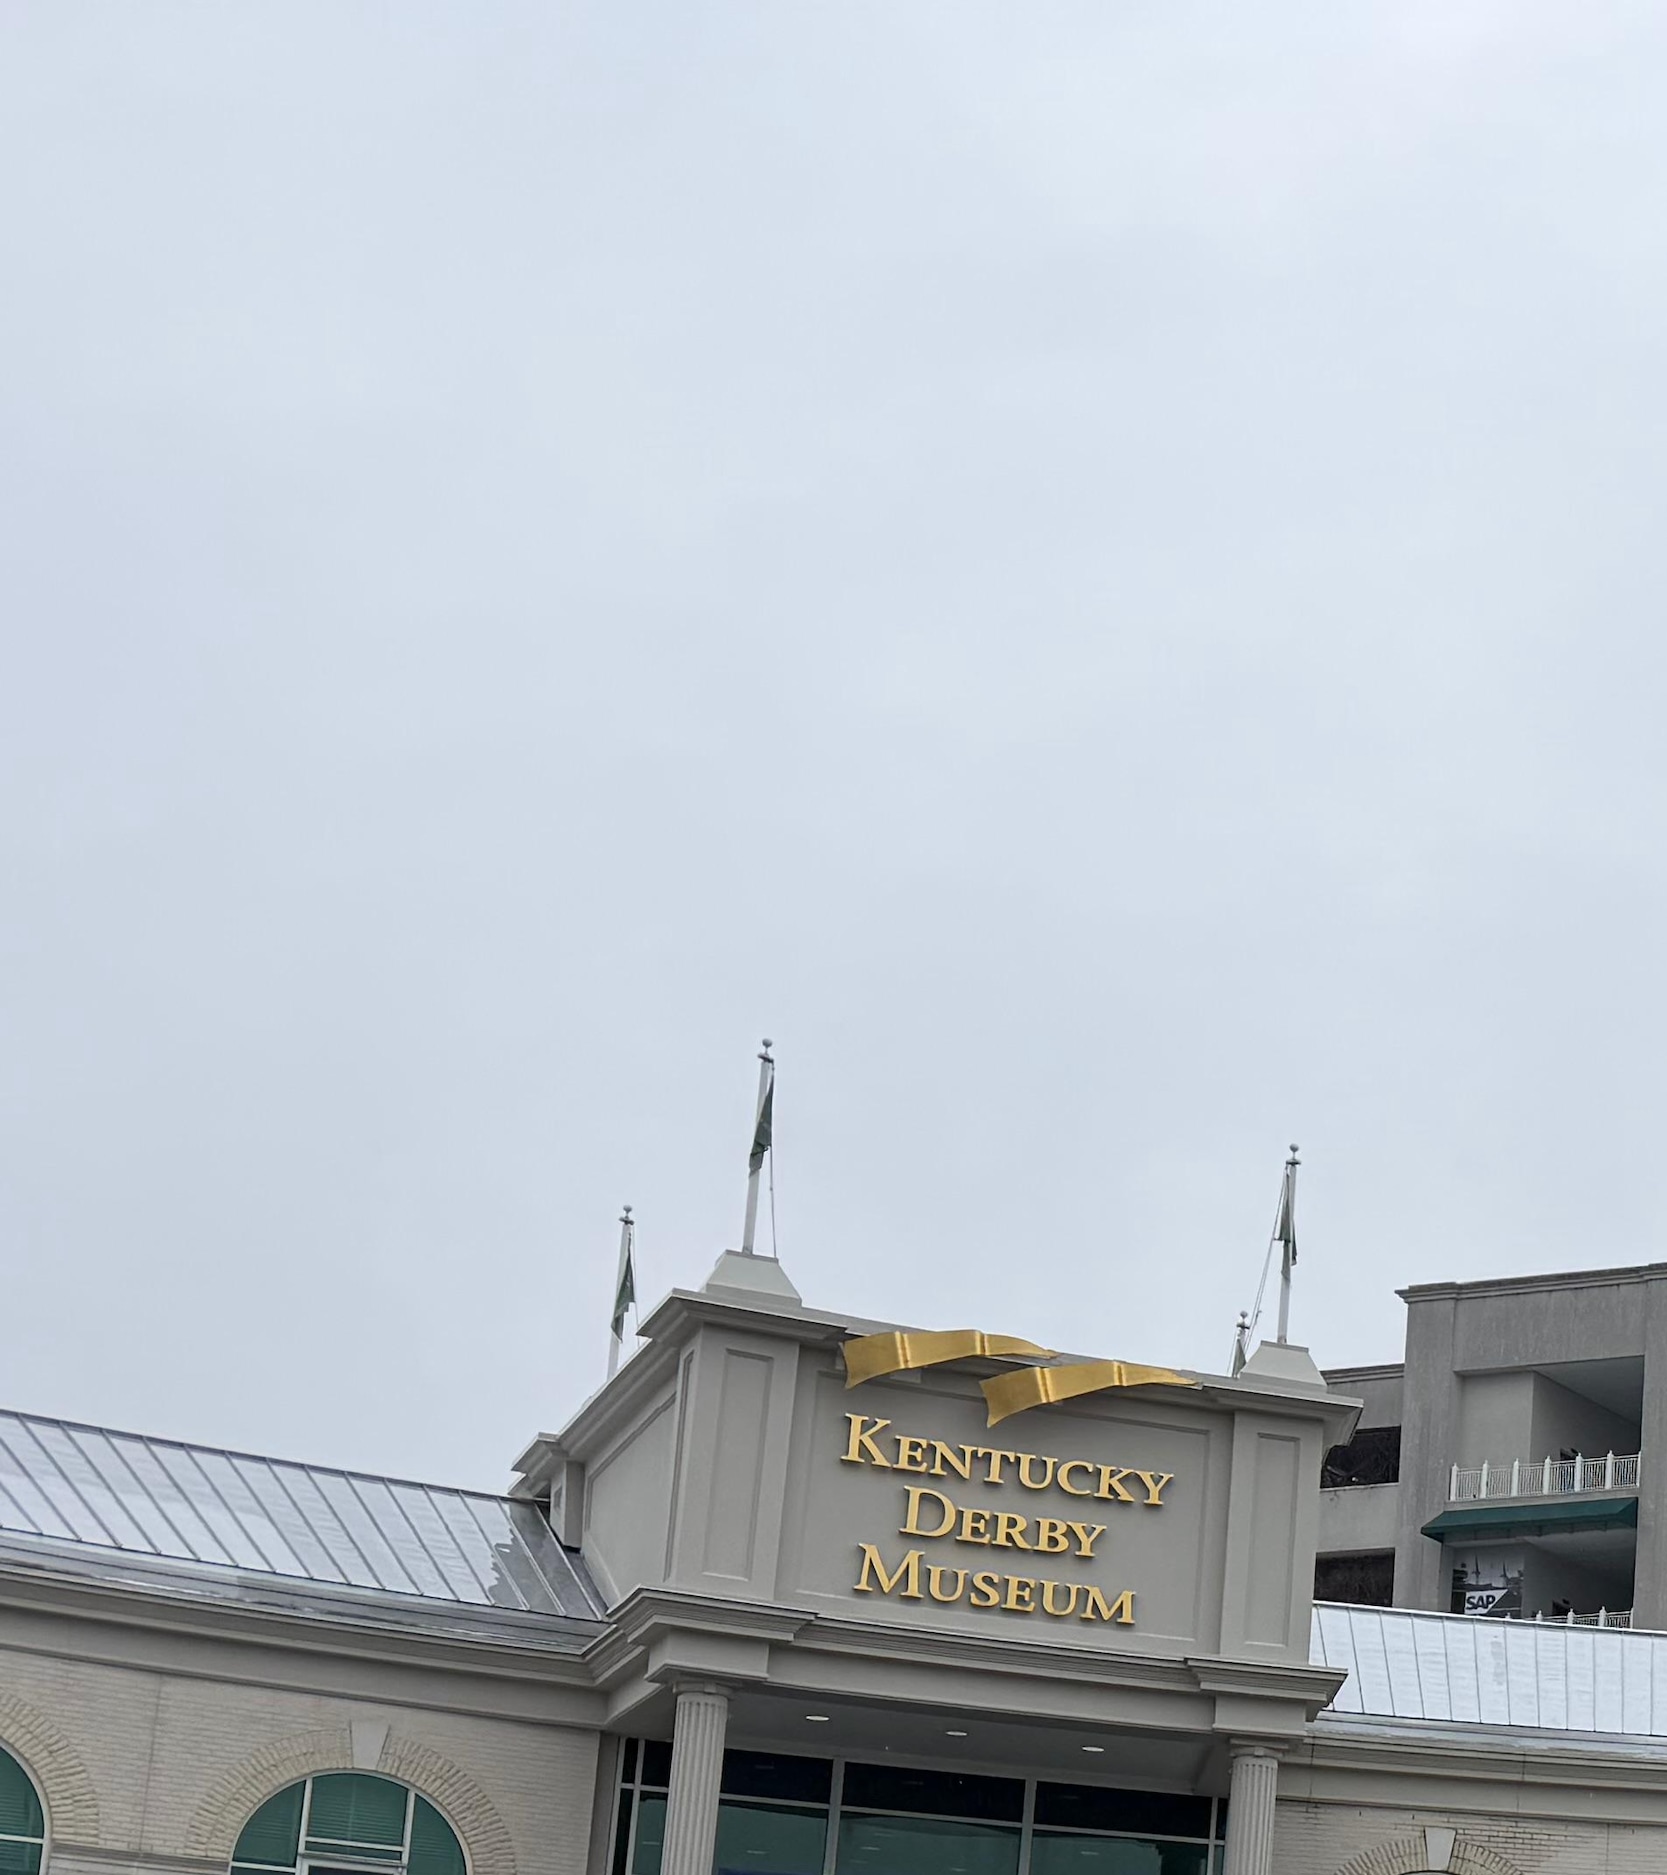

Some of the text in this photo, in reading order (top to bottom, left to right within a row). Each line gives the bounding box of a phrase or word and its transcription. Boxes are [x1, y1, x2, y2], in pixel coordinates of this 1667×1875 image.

[840, 1412, 1174, 1506] KENTUCKY
[899, 1485, 1106, 1558] DERBY
[853, 1542, 1136, 1626] MUSEUM
[1466, 1595, 1495, 1610] SAP
